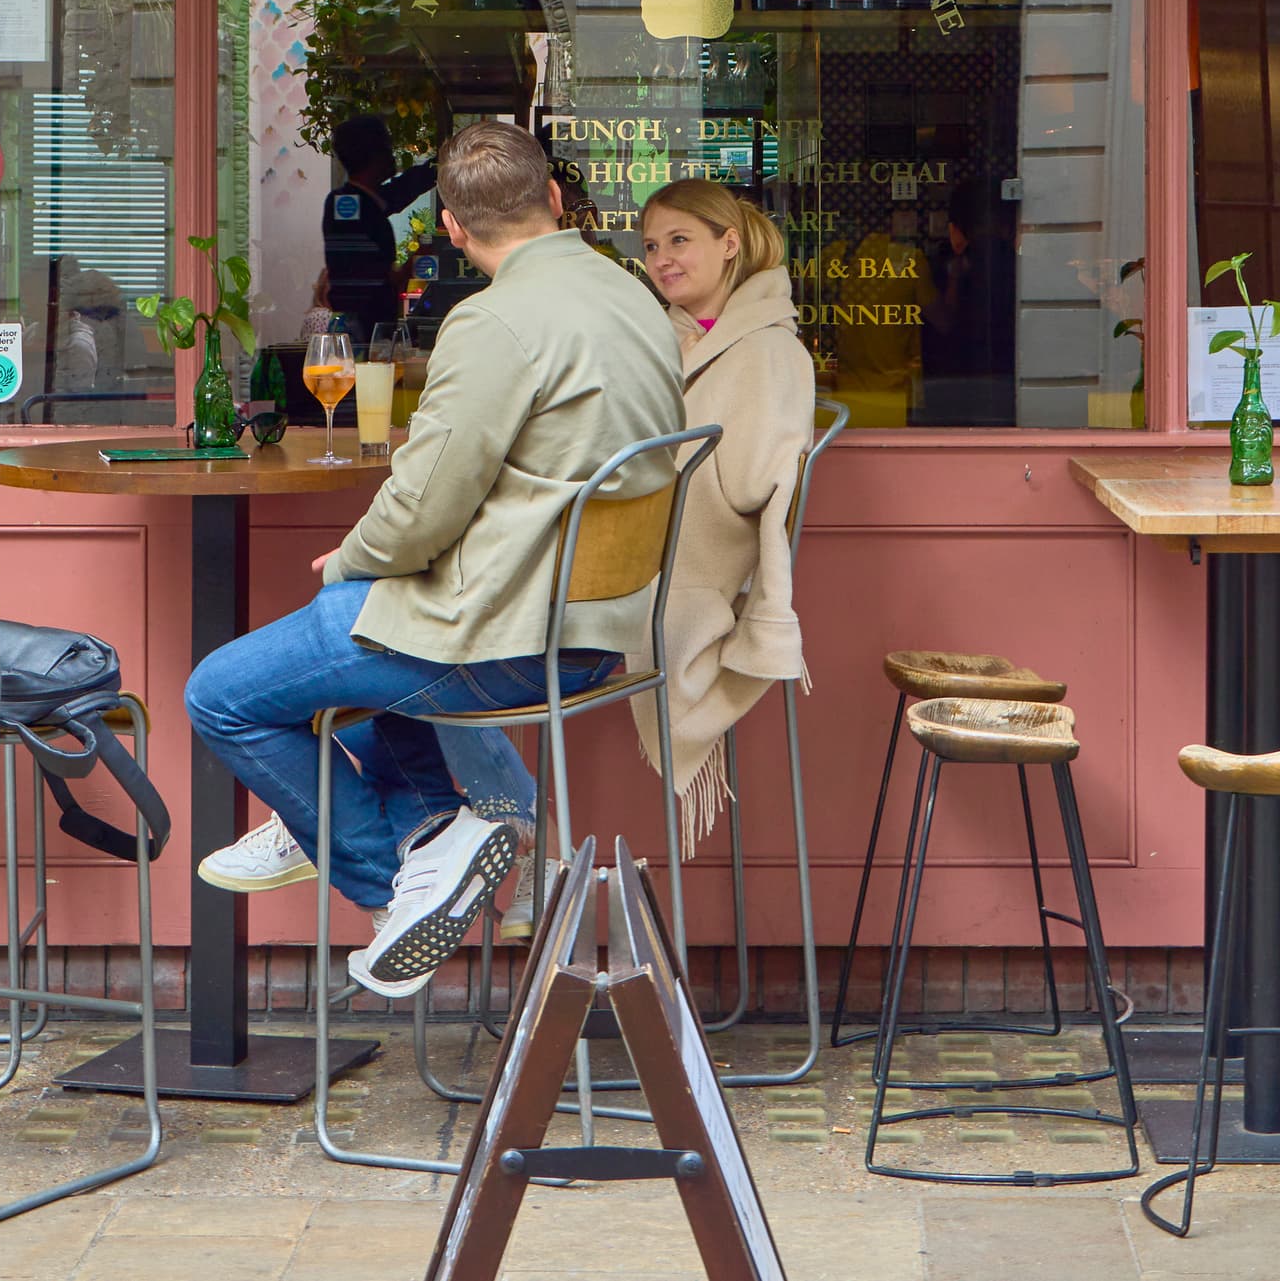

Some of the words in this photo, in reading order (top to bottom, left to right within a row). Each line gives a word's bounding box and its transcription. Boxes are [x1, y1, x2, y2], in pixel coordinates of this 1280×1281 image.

[549, 119, 662, 141] LUNCH
[697, 119, 826, 141] DINNER
[588, 162, 673, 183] HIGH
[681, 162, 744, 183] TEA
[777, 162, 862, 184] HIGH
[870, 162, 948, 183] CHAI
[562, 210, 639, 232] RAFT
[826, 258, 850, 279] &
[858, 258, 920, 279] BAR
[797, 304, 925, 326] DINNER
